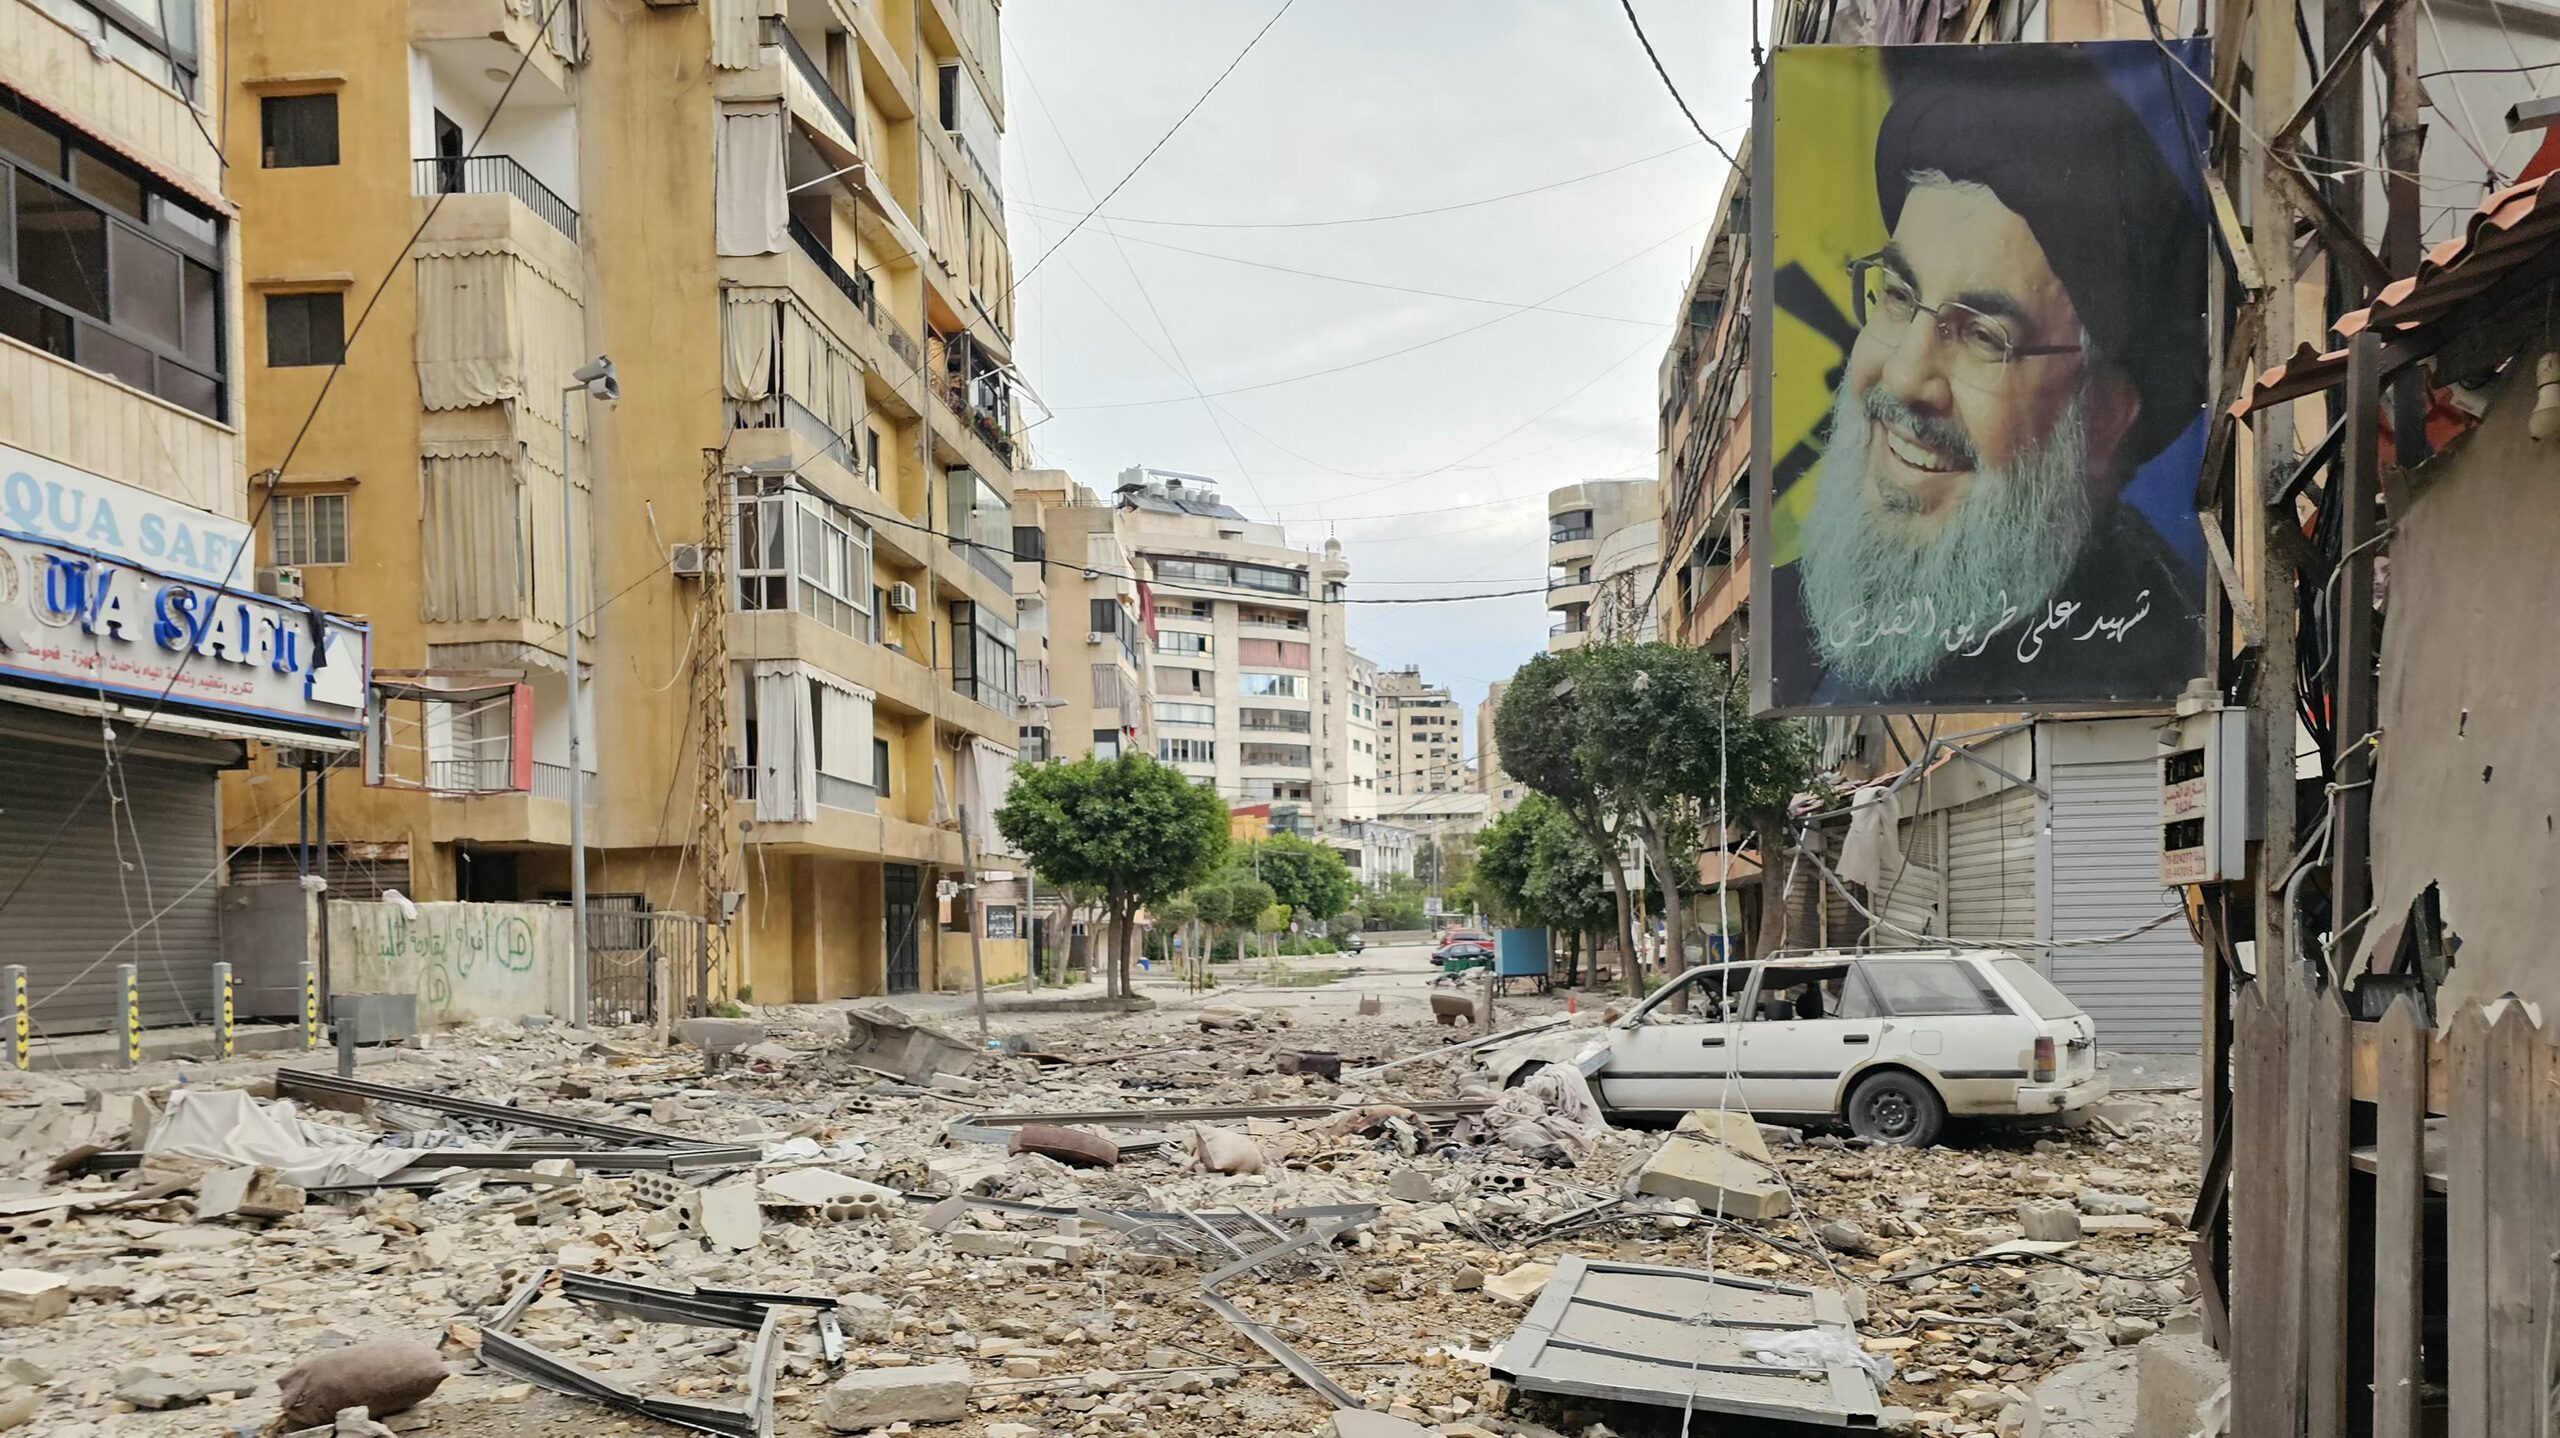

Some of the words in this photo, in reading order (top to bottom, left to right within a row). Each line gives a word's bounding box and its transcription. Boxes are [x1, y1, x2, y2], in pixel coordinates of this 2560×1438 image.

[0, 472, 124, 546] QUA
[138, 513, 243, 580] SAFI
[154, 585, 298, 674] SAFI
[1829, 594, 1936, 648] القدس
[1941, 590, 2019, 657] طريق
[2073, 589, 2150, 643] شهيد
